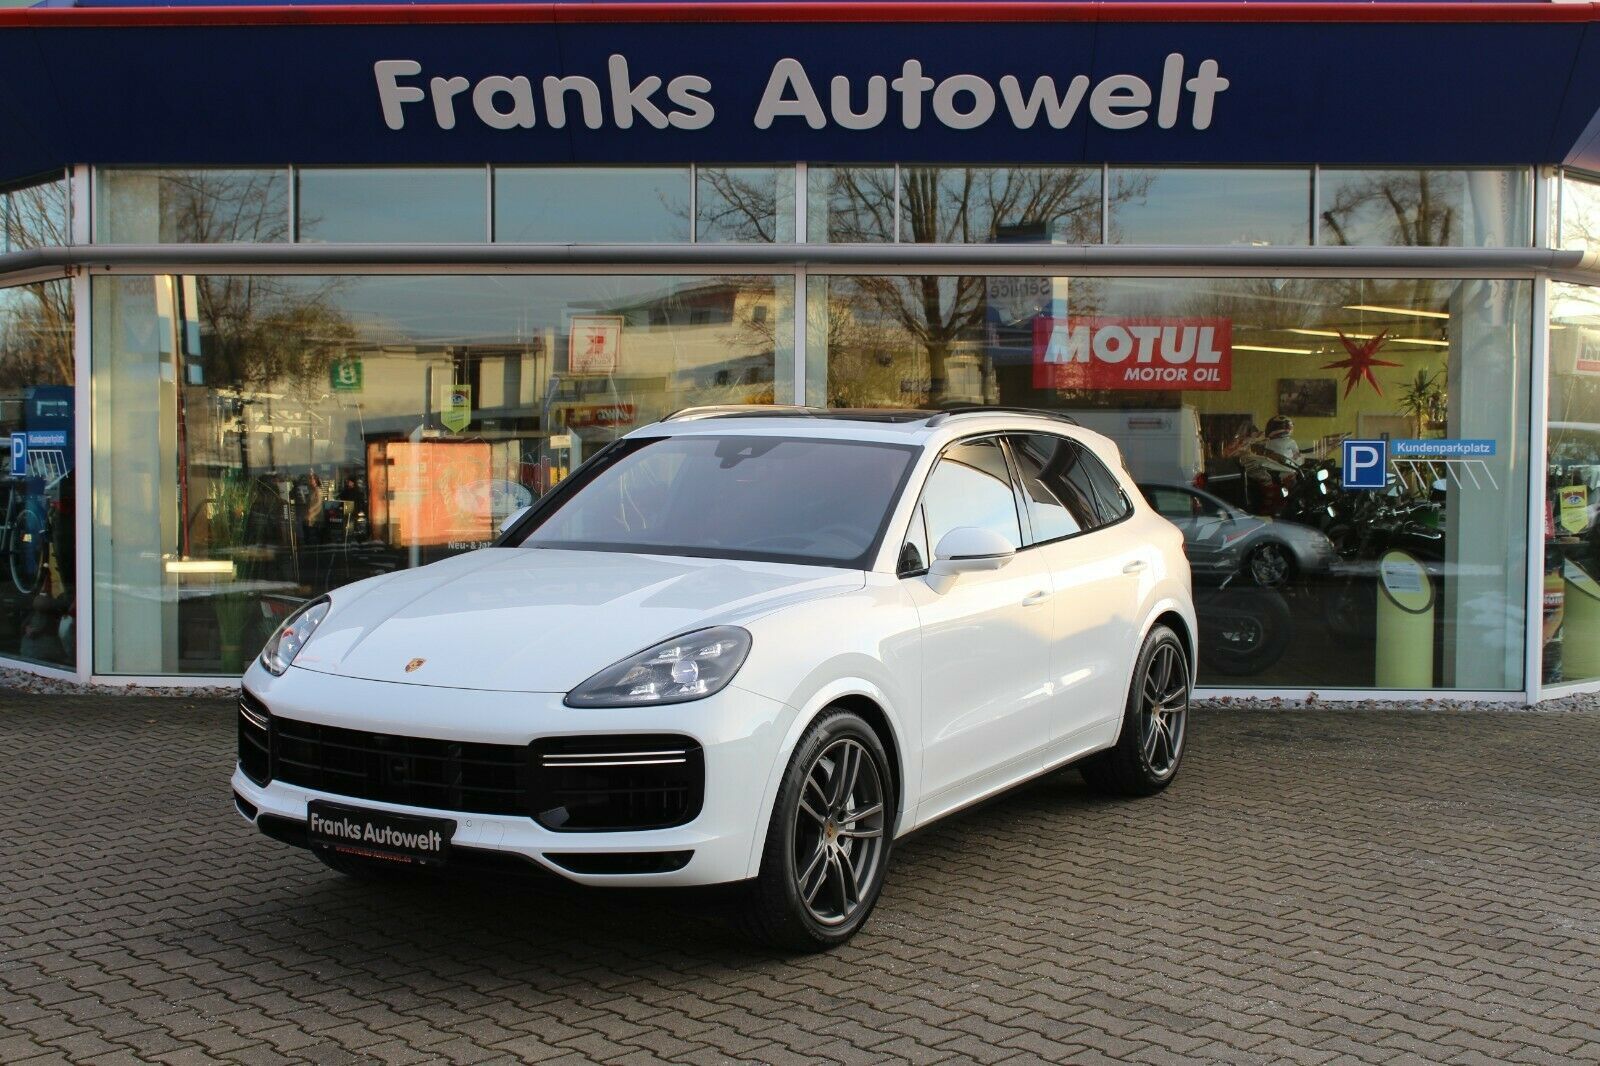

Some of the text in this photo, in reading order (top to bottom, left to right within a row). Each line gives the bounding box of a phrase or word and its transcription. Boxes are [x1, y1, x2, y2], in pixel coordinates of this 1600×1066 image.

[374, 52, 1231, 130] Franks Autowelt
[1044, 325, 1222, 364] MOTUL
[1124, 367, 1221, 382] MOTOR OIL
[14, 438, 24, 470] P
[1350, 446, 1379, 482] P
[1397, 442, 1490, 455] Kundenparkplatz
[312, 813, 441, 851] Franks Autowelt
